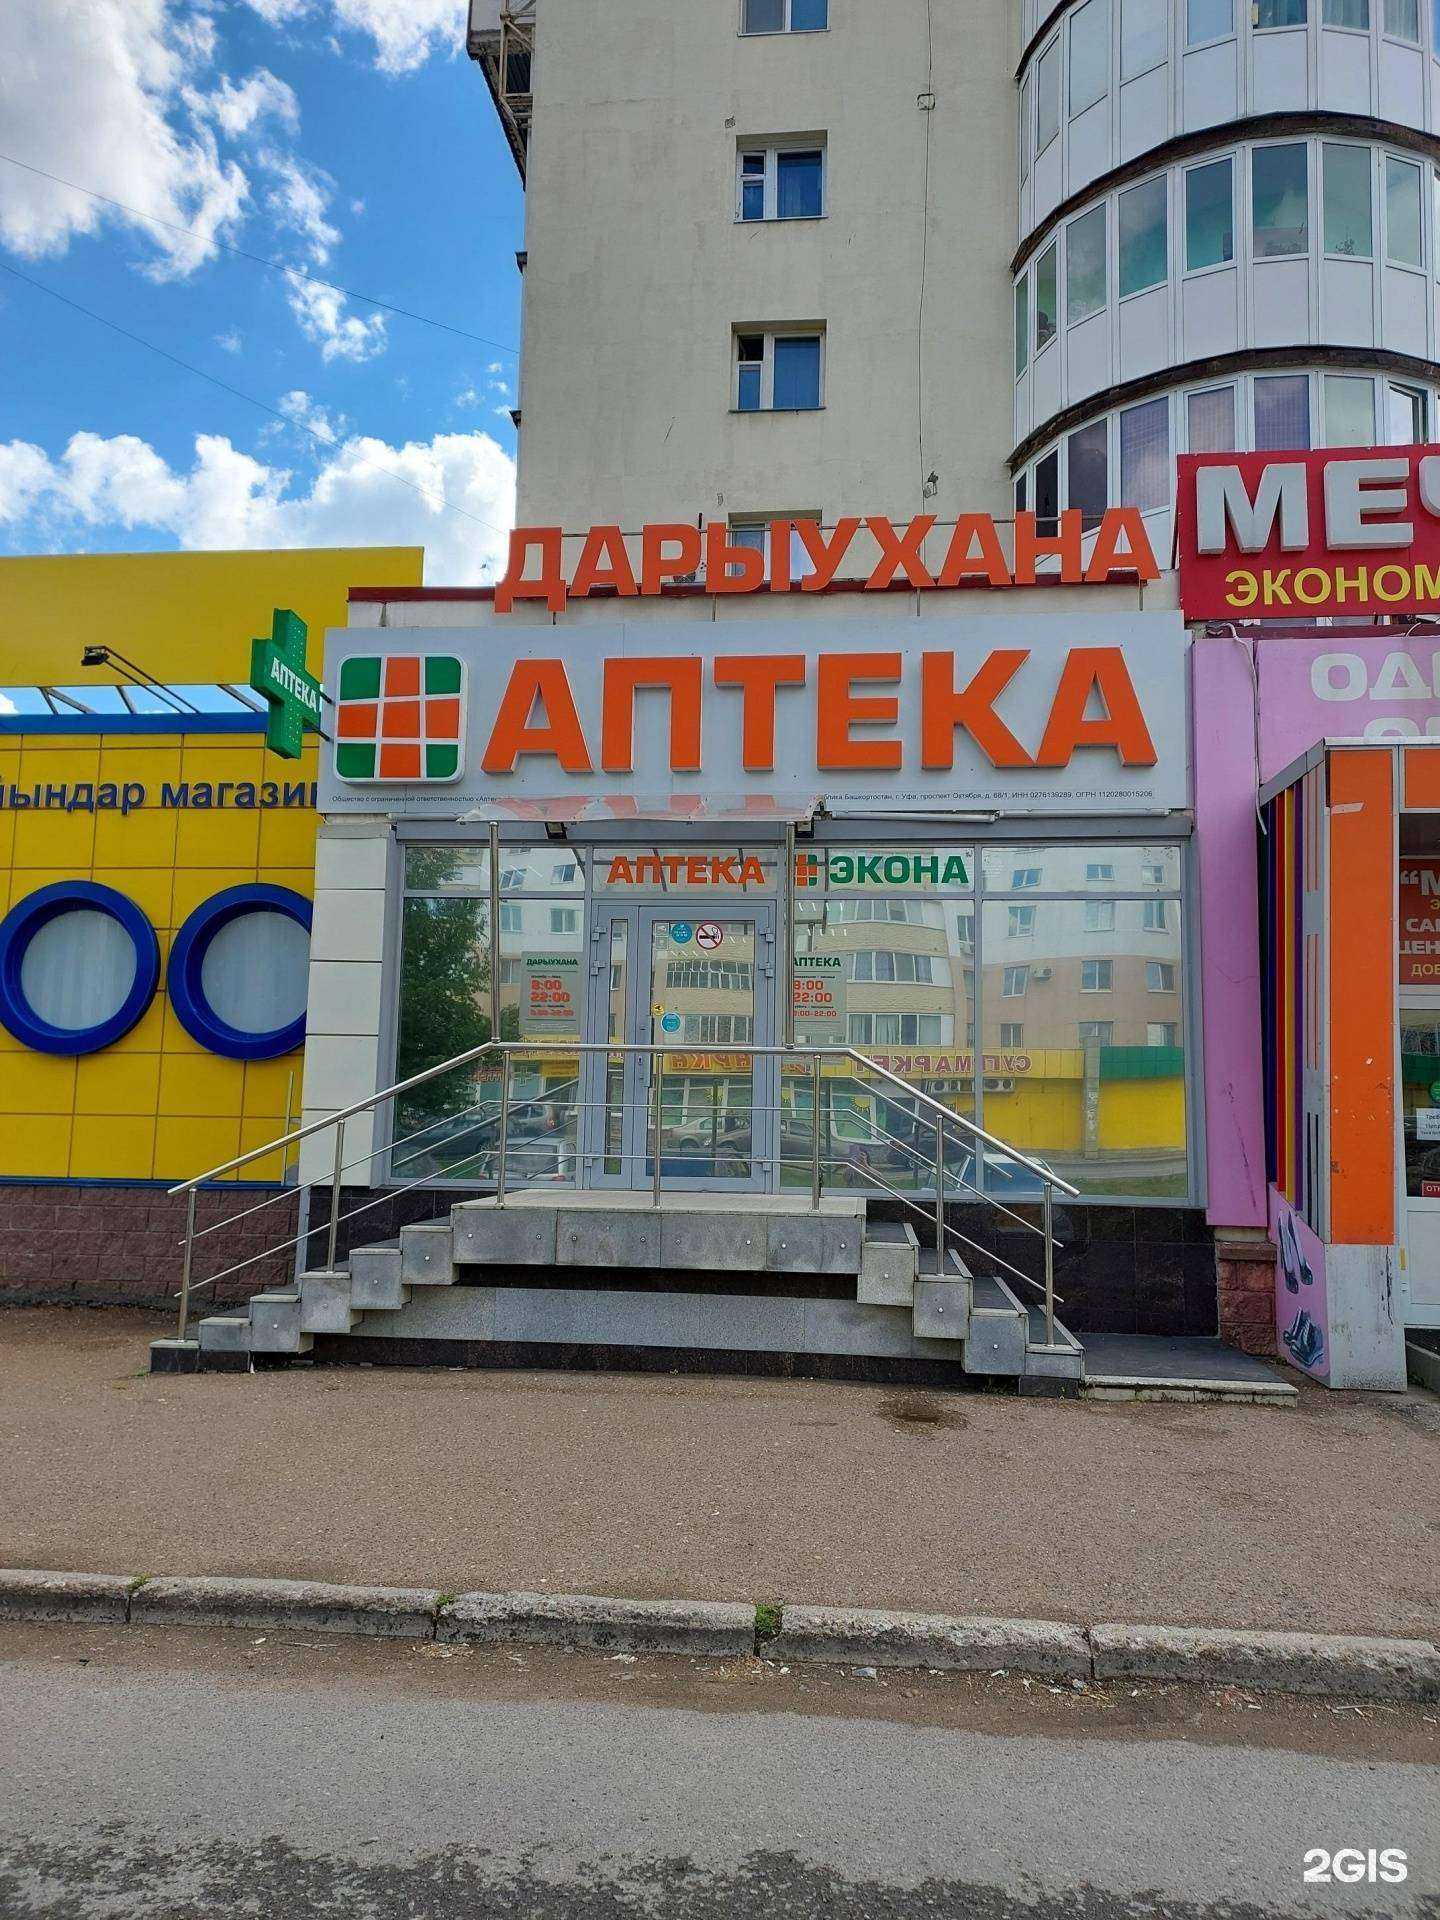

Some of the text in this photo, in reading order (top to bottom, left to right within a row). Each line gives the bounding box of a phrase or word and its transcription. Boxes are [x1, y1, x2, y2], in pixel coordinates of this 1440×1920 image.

[1196, 457, 1440, 555] МЕ
[494, 507, 1161, 613] ДАРЫУХАНА
[271, 657, 317, 713] АПТЕКА
[1311, 651, 1440, 702] ОД
[481, 647, 1158, 774] АПТЕКА
[0, 776, 145, 815] ындар
[607, 856, 765, 884] АПТЕКА
[829, 856, 969, 884] ЭКОНА
[526, 958, 578, 967] ДАРЫУХАНА
